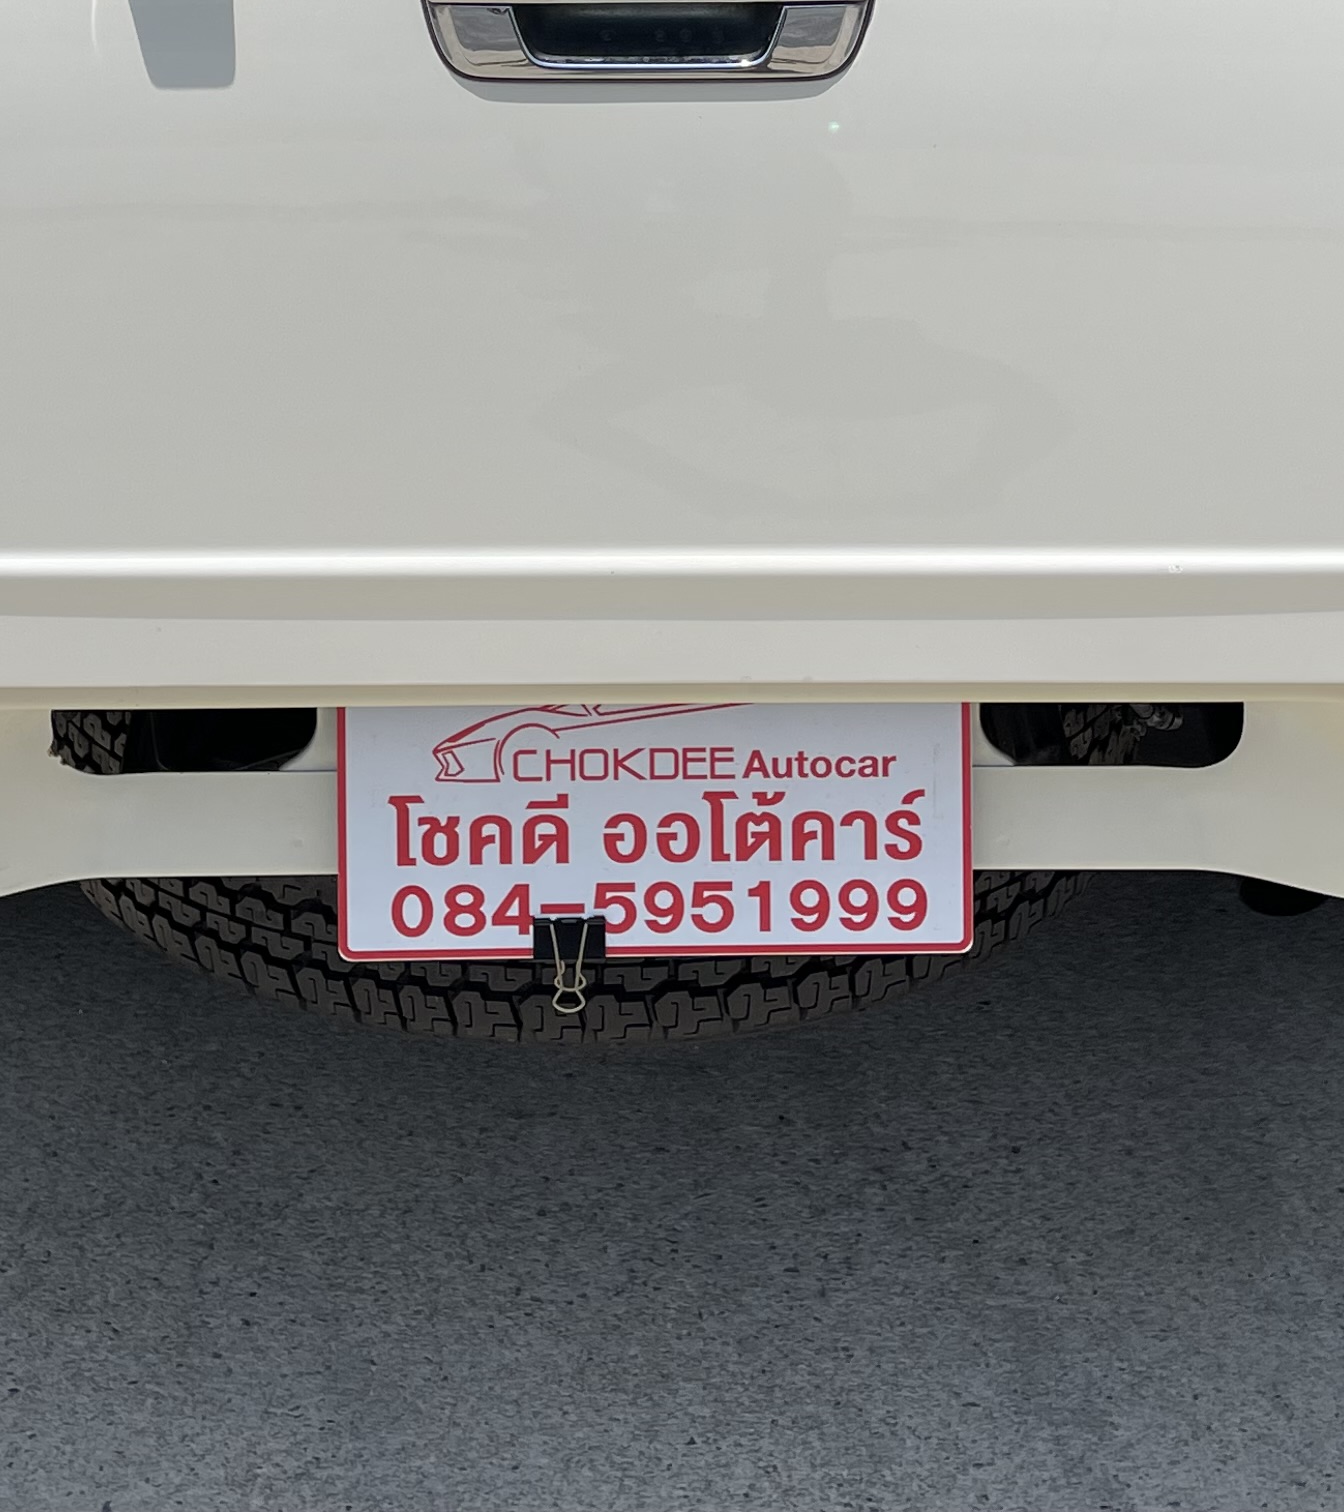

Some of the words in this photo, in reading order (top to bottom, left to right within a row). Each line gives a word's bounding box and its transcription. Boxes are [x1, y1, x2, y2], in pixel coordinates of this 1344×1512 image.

[512, 746, 736, 782] CHOKDEE
[742, 749, 897, 779] Autocar
[388, 793, 570, 867] โชคดี
[602, 789, 926, 864] ออโต้คาร์
[391, 878, 929, 938] 084-5951999
